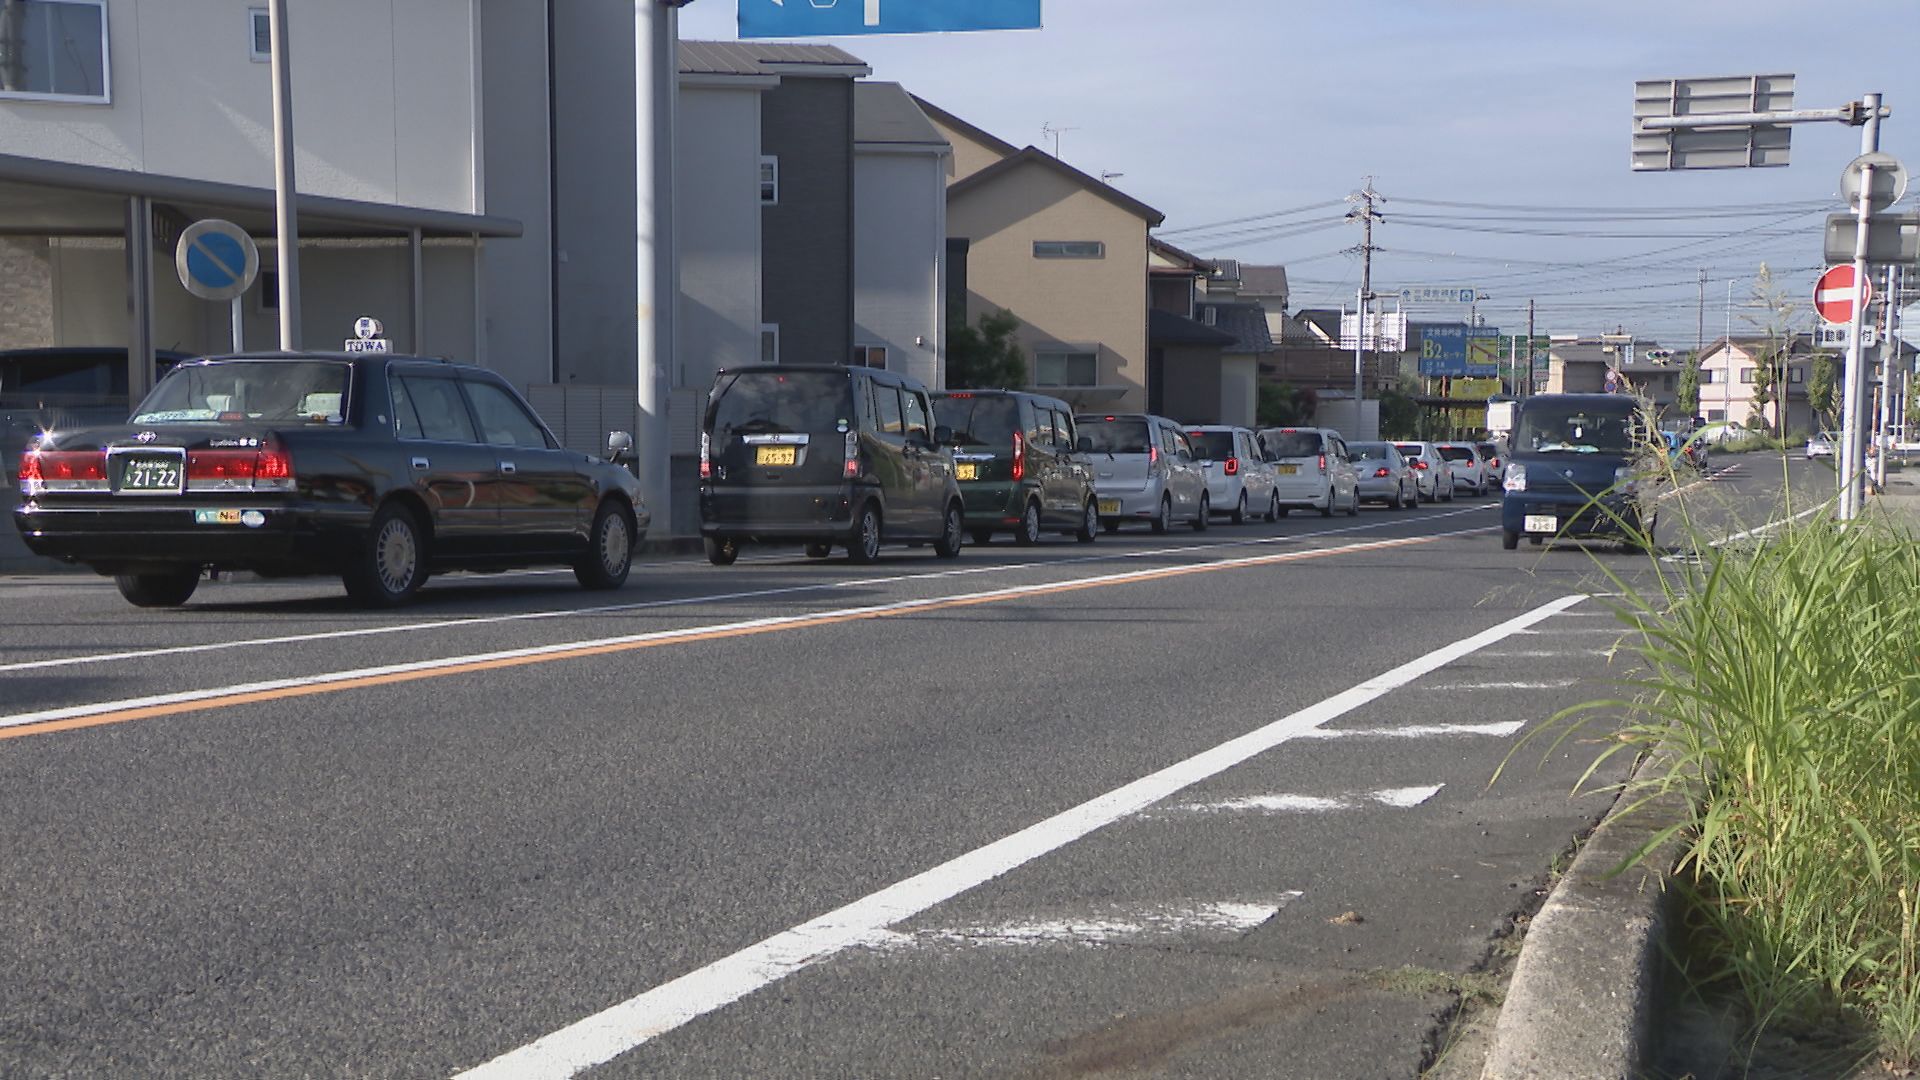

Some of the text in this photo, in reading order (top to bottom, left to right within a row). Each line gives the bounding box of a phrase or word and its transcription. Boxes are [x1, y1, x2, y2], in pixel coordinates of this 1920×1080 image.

[1815, 329, 1872, 342] 自動車・付
[347, 341, 384, 352] TOWA
[1423, 339, 1442, 359] B2
